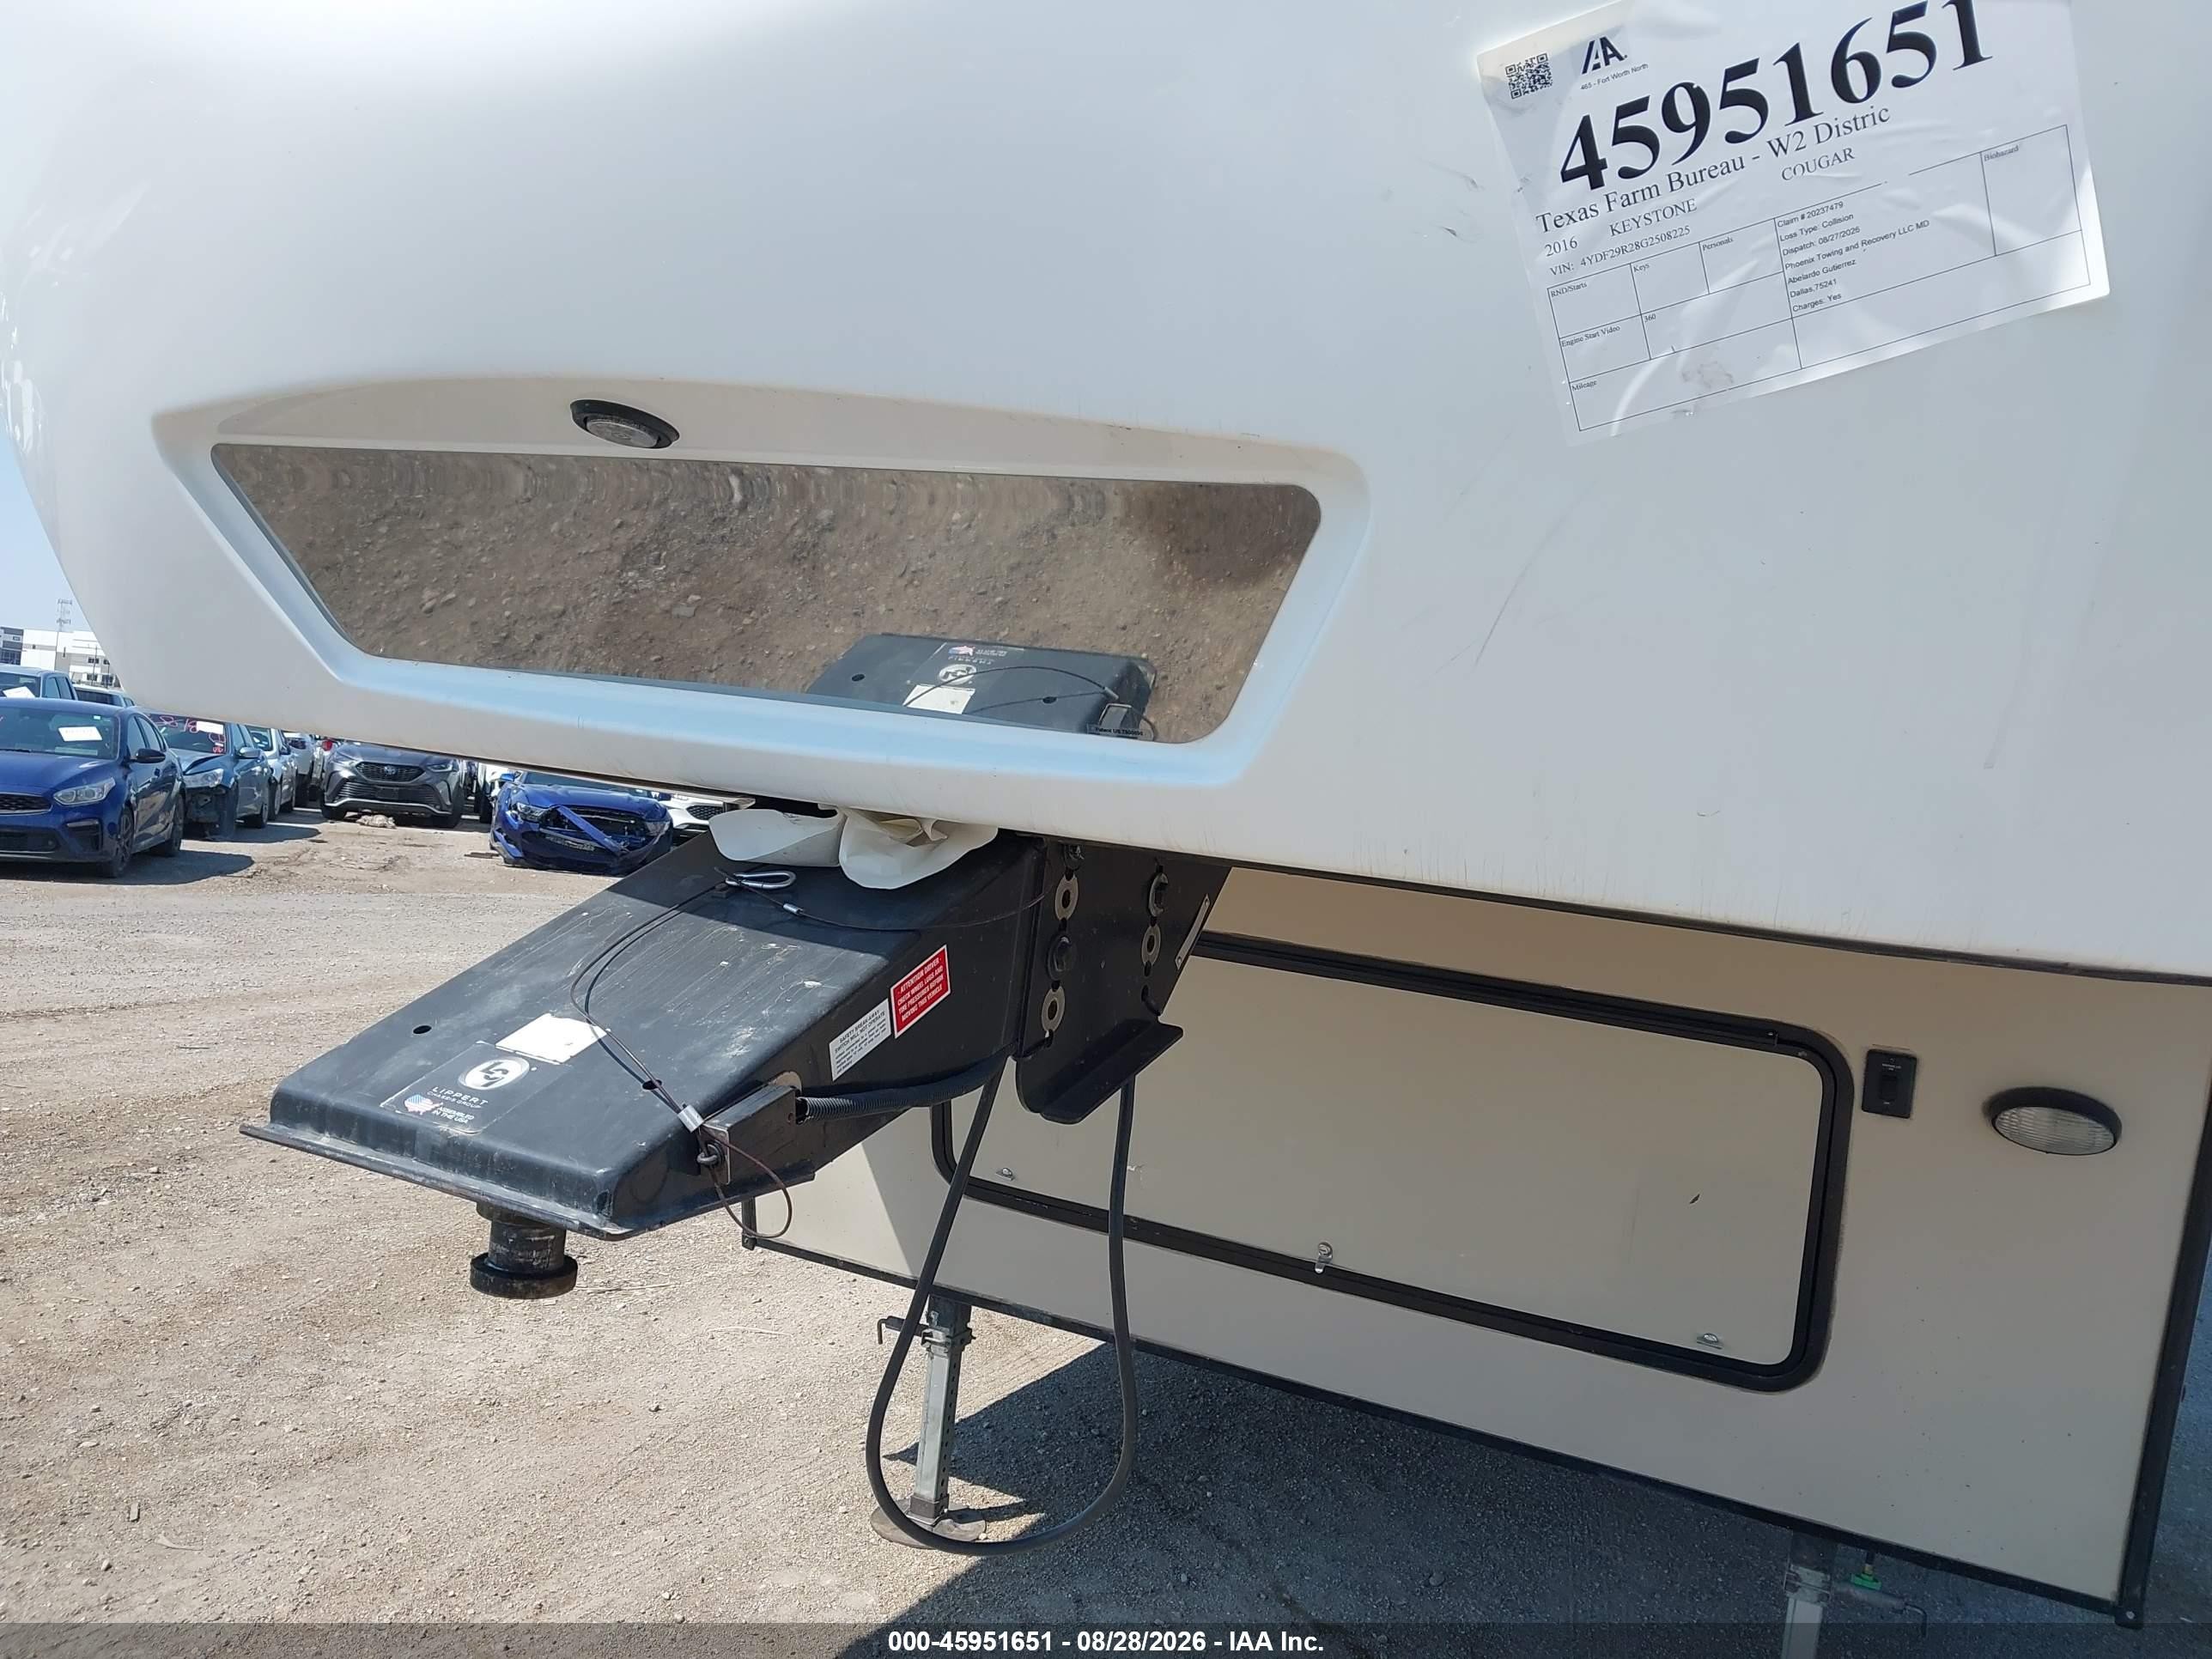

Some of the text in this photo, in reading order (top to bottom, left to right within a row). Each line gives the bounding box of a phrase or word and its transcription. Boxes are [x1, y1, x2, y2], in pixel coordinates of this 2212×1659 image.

[1597, 76, 1610, 85] Fort
[1611, 70, 1631, 80] Worth
[1632, 64, 1649, 73] North
[1560, 0, 1992, 190] 45951651
[1984, 144, 2019, 161] Biohazard
[1535, 204, 1599, 233] Texas
[1604, 183, 1661, 212] Farm
[1667, 156, 1745, 193] Bureau
[1766, 131, 1807, 159] W2
[1814, 106, 1890, 144] Distric
[1545, 147, 1855, 258] 2016 KEYSTONE COUGAR
[1778, 216, 1799, 228] Claim
[1807, 201, 1844, 218] 20237479
[1780, 214, 1854, 241] Loss Type: Collision
[1550, 225, 1691, 276] VIN: 4YDF29R28G2508225
[1702, 236, 1734, 251] Personals
[1783, 241, 1816, 256] Dispatch:
[1785, 220, 1929, 270] Phoenix Towing and Recovery LLC MD
[1633, 263, 1650, 274] Keys
[1788, 259, 1856, 284] Abelardo Gutierrez
[1792, 293, 1842, 312] Charges: Yes
[1644, 313, 1656, 323] 360
[1561, 325, 1620, 348] Engine Start Video
[1571, 380, 1597, 392] Mileage
[900, 956, 939, 994] ATTENTION DRIVER
[839, 1028, 854, 1043] SAFETY
[432, 1086, 489, 1105] LIPPERT
